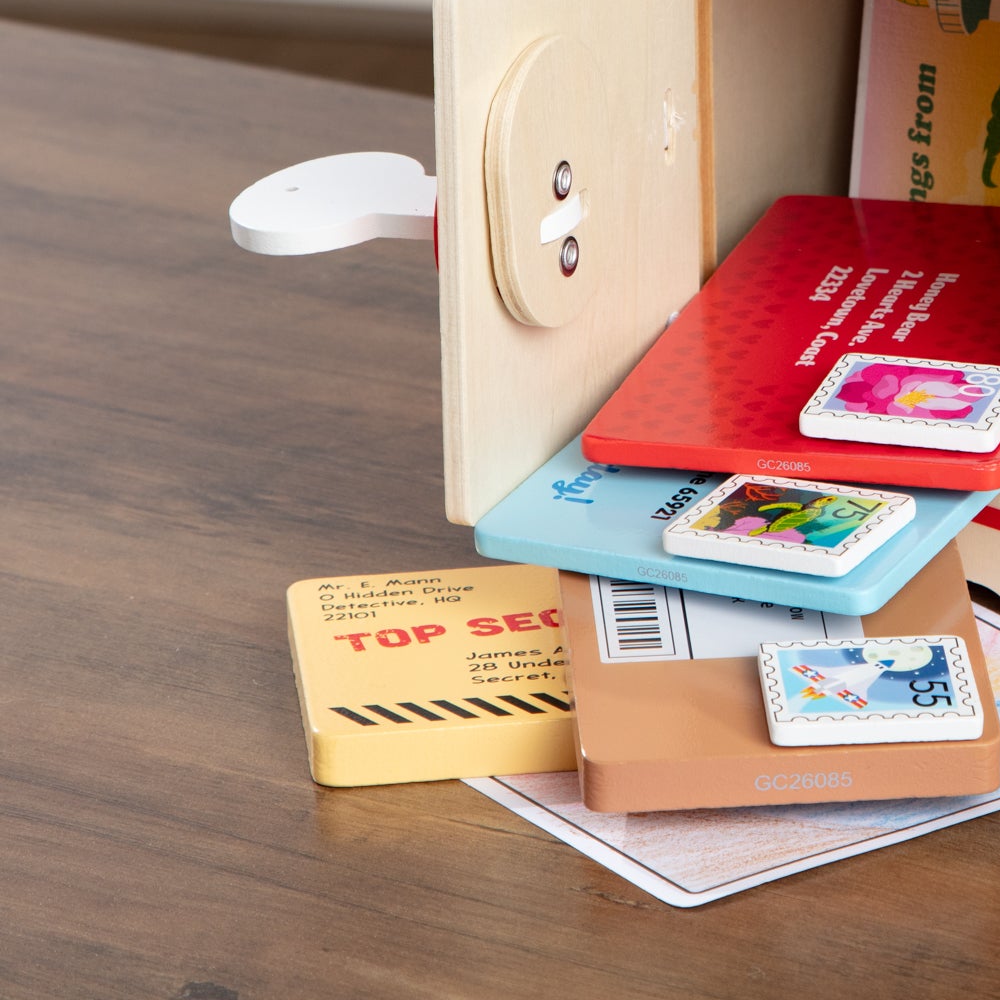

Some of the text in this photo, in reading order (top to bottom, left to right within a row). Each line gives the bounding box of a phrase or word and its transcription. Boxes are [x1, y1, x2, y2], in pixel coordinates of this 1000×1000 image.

[907, 63, 937, 147] from
[808, 265, 854, 302] 22334
[794, 267, 890, 367] Lovetown, Coast
[848, 270, 924, 346] 2 Hearts Ave.
[891, 272, 961, 342] Honey Bear
[756, 458, 812, 472] GC26085
[650, 487, 698, 521] 65921
[832, 499, 882, 521] 75
[318, 583, 351, 591] Mr.
[386, 577, 442, 586] Mann
[637, 566, 688, 583] GC26085
[344, 588, 414, 599] Hidden
[423, 585, 475, 594] Drive
[434, 595, 461, 604] HQ
[324, 610, 377, 621] 22101
[333, 624, 446, 652] TOP
[466, 649, 542, 660] James
[469, 662, 498, 672] 28
[908, 679, 953, 708] 55
[753, 771, 853, 792] GC26085
